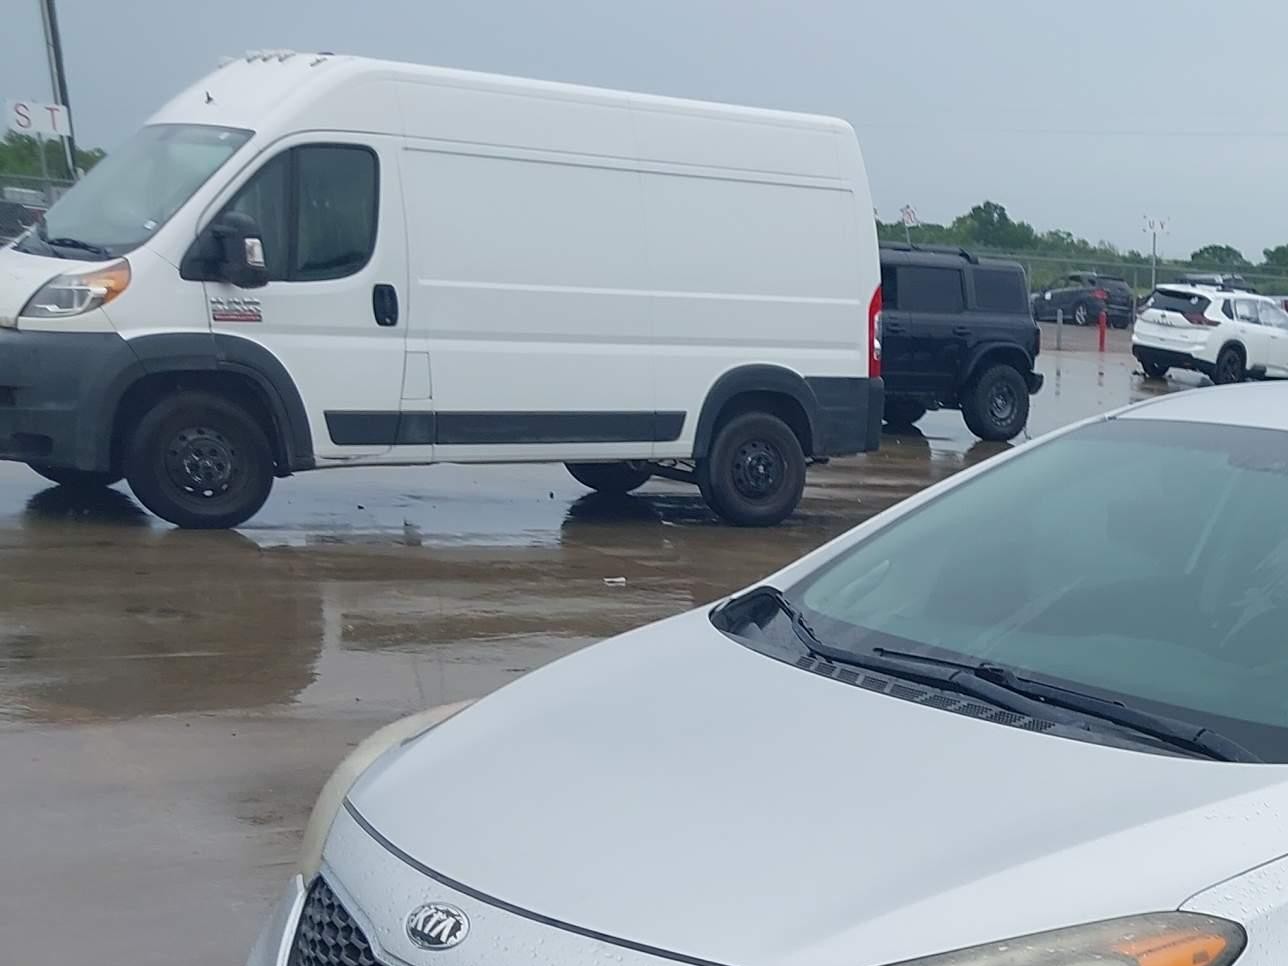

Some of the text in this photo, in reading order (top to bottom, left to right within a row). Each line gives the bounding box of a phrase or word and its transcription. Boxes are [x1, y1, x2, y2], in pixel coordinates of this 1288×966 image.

[14, 102, 61, 132] S T
[410, 905, 458, 944] KIA
